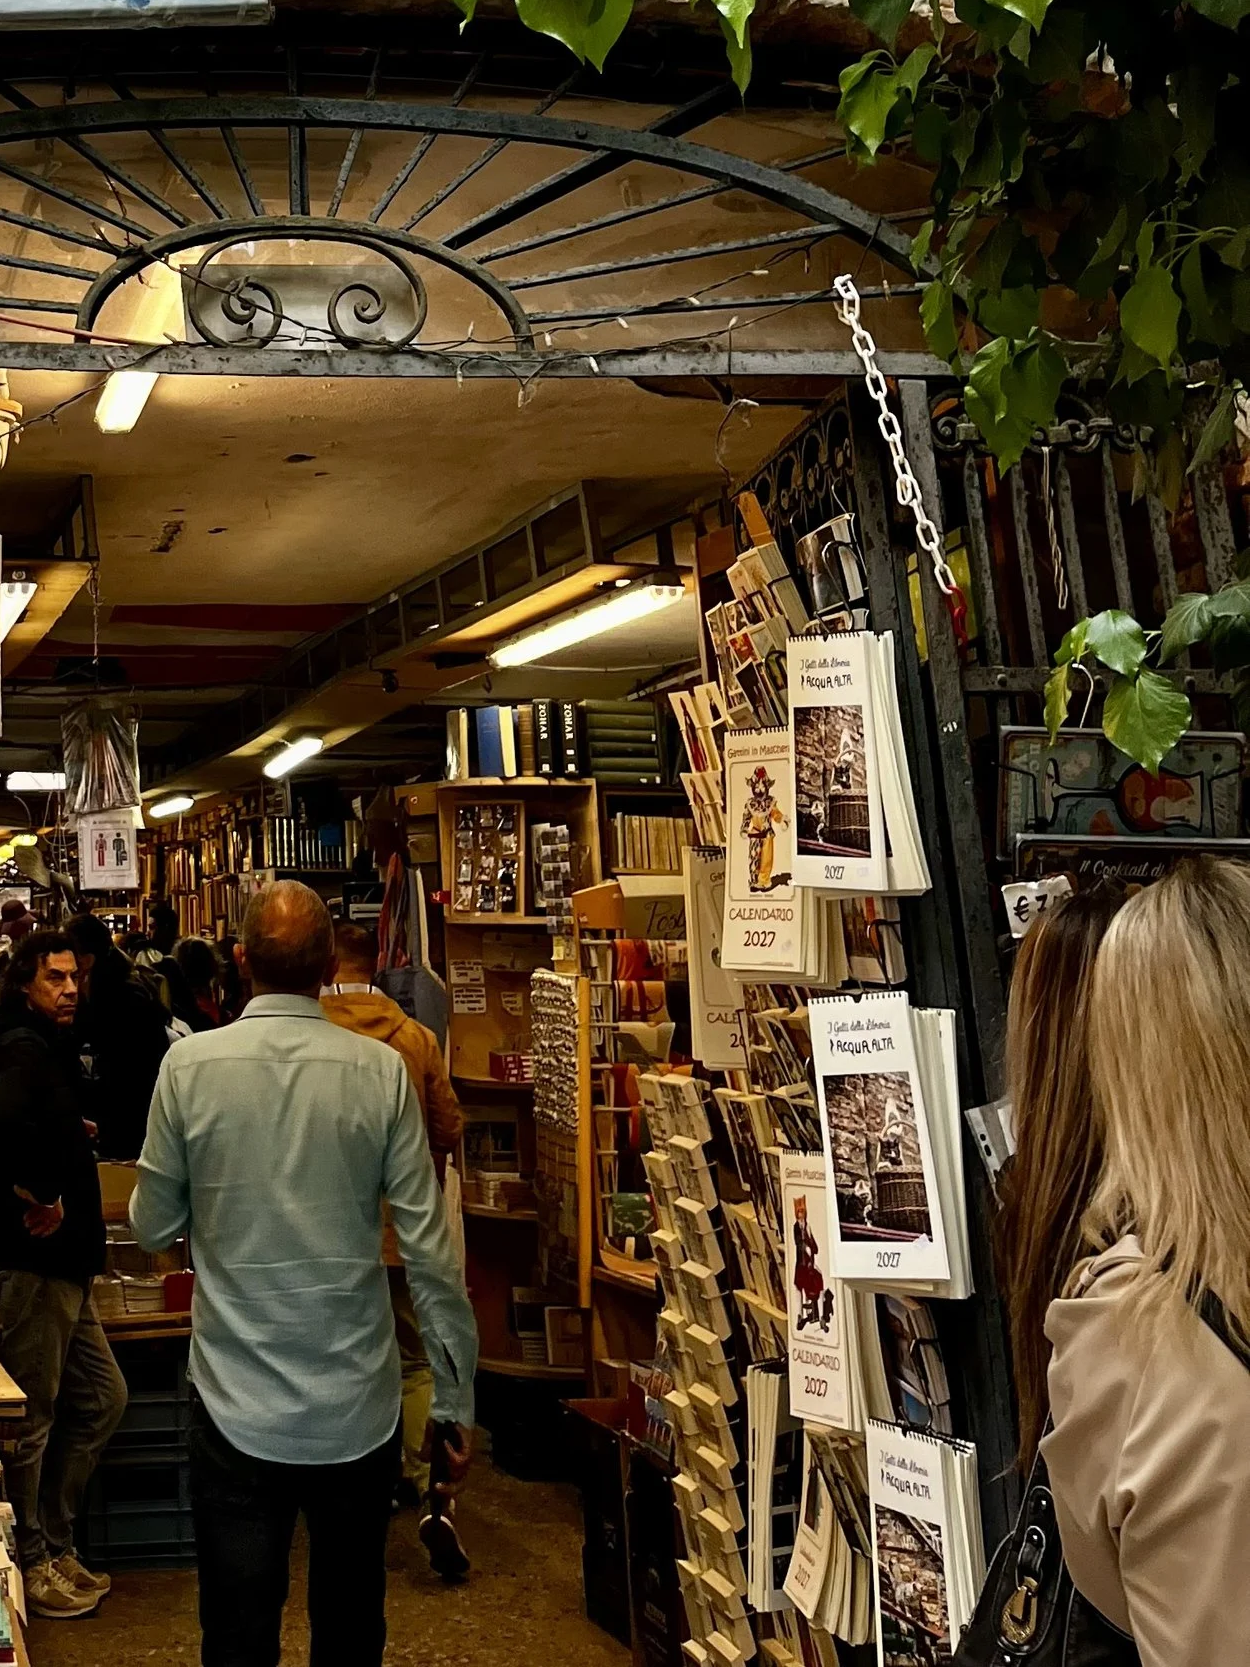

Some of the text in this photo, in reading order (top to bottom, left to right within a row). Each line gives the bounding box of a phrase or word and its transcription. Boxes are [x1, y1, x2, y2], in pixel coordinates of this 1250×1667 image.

[806, 673, 853, 690] ACQUA ALTA
[538, 703, 549, 740] ZOHAR
[563, 703, 574, 740] ZOHAR
[824, 864, 845, 880] 2027
[1093, 859, 1150, 878] Cocktail
[729, 907, 794, 922] CALENDARIO
[743, 930, 776, 947] 2027
[836, 1037, 896, 1057] ACQUA ALTA
[876, 1251, 901, 1268] 2027
[792, 1347, 841, 1372] CALENDARIO
[804, 1375, 828, 1398] 2027
[885, 1471, 932, 1500] ACQUA ALTA
